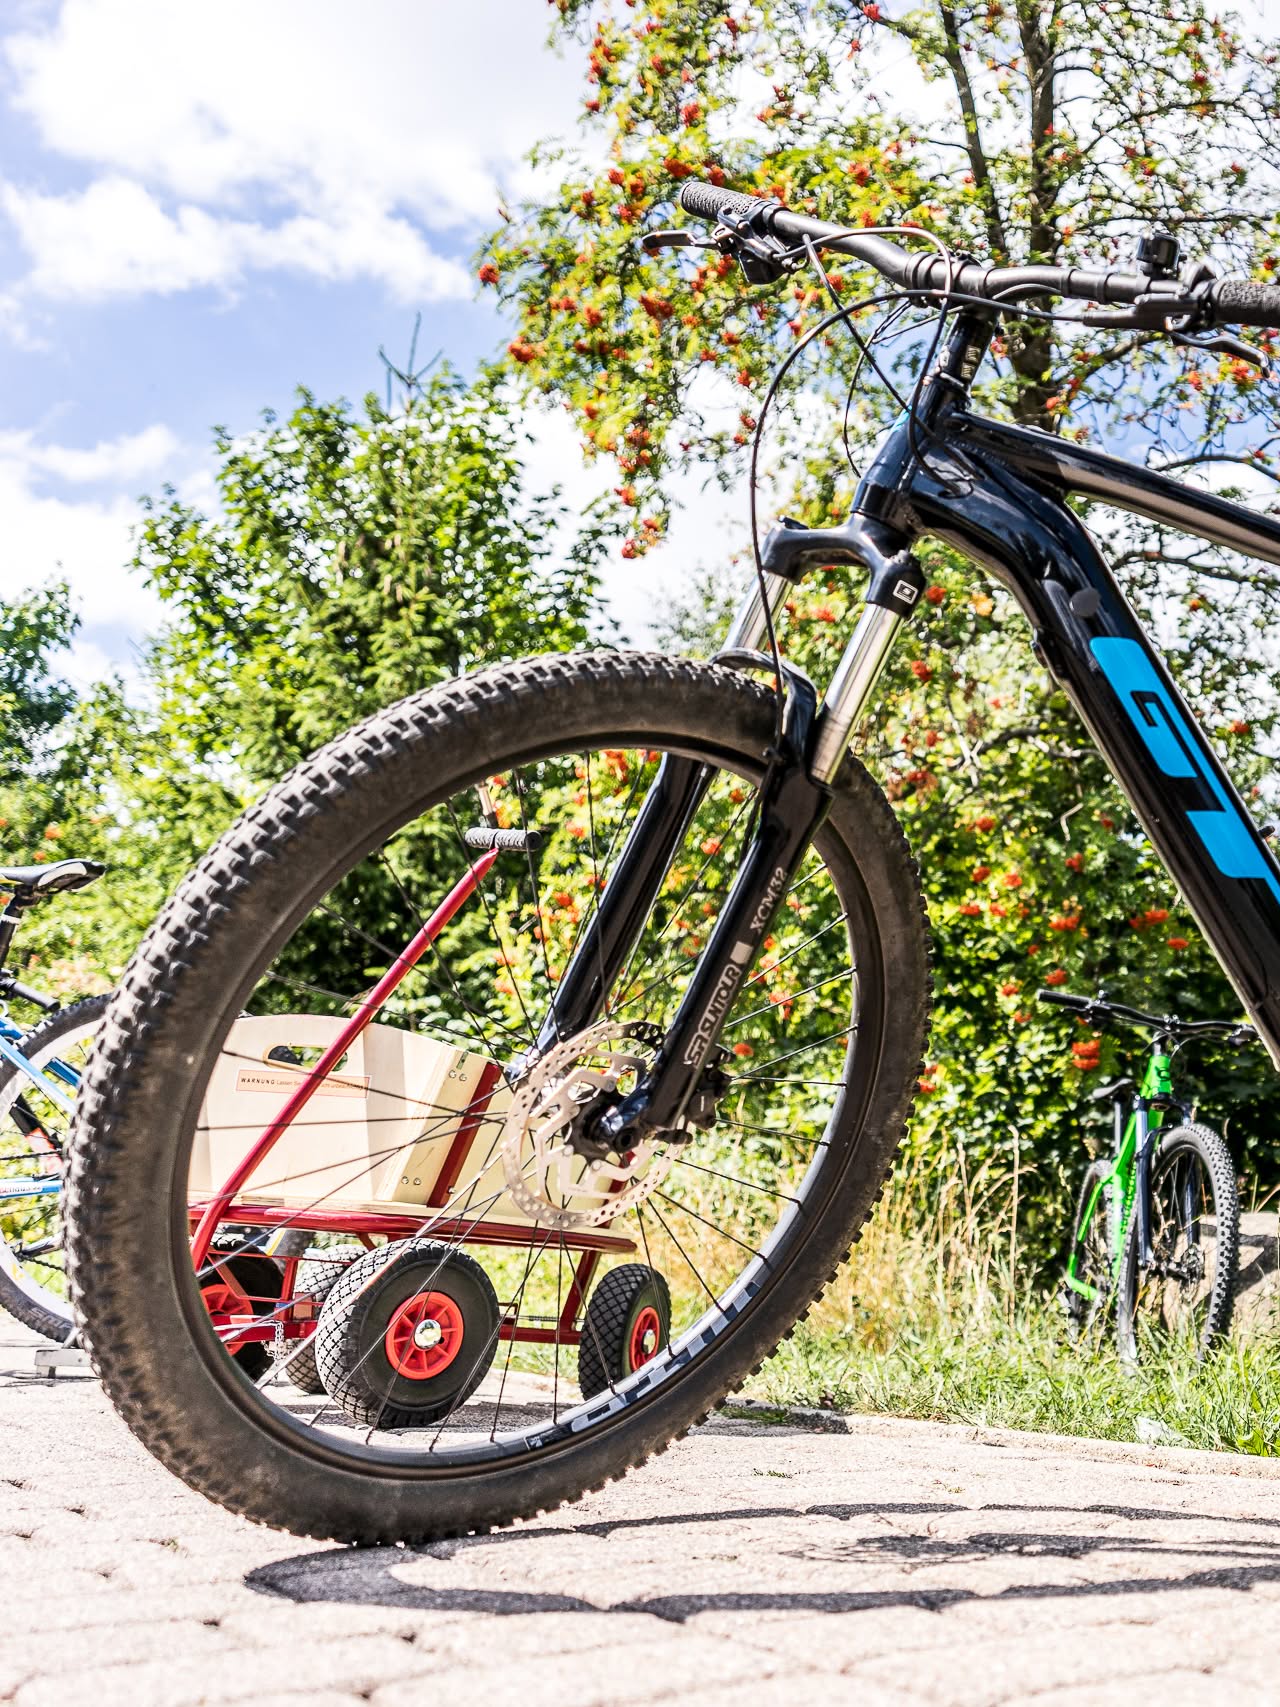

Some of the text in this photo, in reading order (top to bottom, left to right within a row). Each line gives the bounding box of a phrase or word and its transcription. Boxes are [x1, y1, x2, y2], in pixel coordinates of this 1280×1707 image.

[750, 866, 787, 936] XCM32
[699, 963, 744, 1040] SUNTOUR
[241, 1077, 275, 1085] WARNUNG
